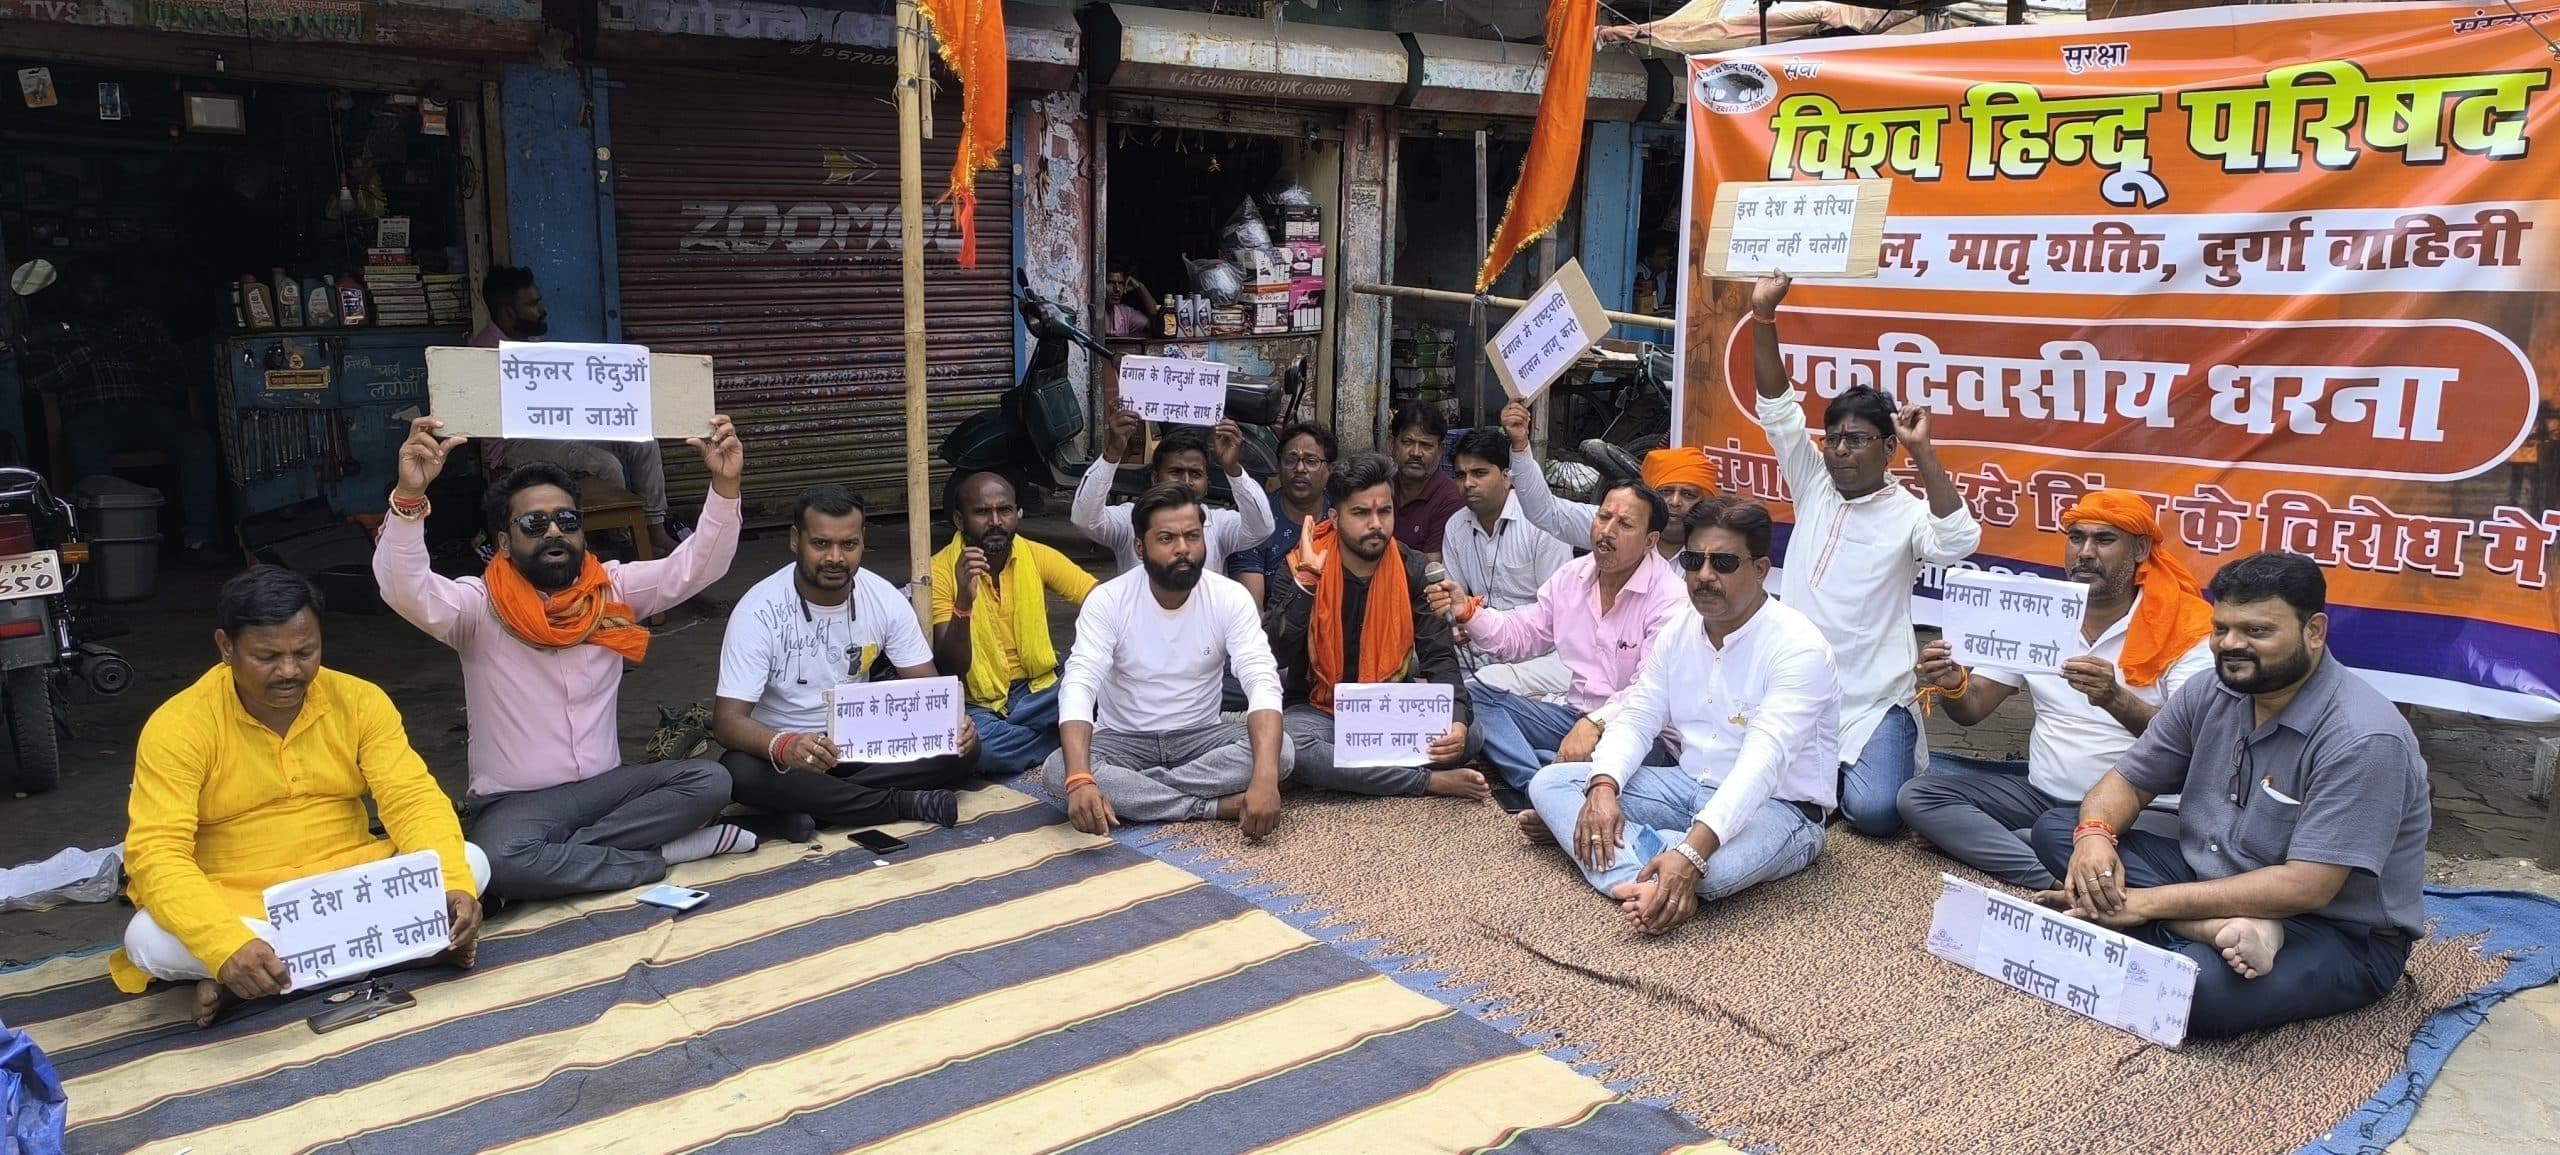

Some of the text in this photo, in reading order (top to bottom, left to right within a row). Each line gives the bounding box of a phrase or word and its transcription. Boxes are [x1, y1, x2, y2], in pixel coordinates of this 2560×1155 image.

[1783, 57, 1824, 81] सेवा
[2062, 43, 2129, 74] सुरक्षा
[1169, 71, 1249, 92] KATCHAHRI
[1768, 59, 2552, 206] विश्व हिन्दू परिषद
[1737, 194, 1855, 220] इस देश में सरिया
[1732, 232, 1849, 261] कानून नहीं चलेगी
[1879, 208, 2534, 288] ल, मातृ शक्ति, दुर्गा वाहिनी
[1501, 292, 1567, 360] बंगाल में राष्ट्रपति
[1517, 317, 1579, 380] शासन लागू करो
[502, 354, 648, 392] सेकुलर हिंदुओं
[1121, 361, 1221, 391] बंगाल के हिन्दुओं संघर्ष
[1778, 332, 2460, 443] एकदिवसीय धरना
[526, 402, 639, 427] जाग जाओ
[1145, 401, 1160, 417] हम
[1163, 401, 1190, 421] तुम्हारे
[1194, 405, 1212, 419] साथ
[1215, 402, 1223, 421] हैं
[1956, 463, 2021, 526] रहे
[2174, 483, 2250, 554] के
[2257, 489, 2474, 577] विरोध
[2479, 504, 2560, 588] में
[1945, 583, 2083, 620] ममता सरकार को
[1964, 630, 2060, 667] बर्खास्त करो
[837, 688, 949, 721] बंगाल के हिन्दुओं संघर्ष
[1336, 693, 1452, 718] बंगाल में राष्ट्रपति
[867, 740, 882, 758] हम
[888, 732, 918, 758] तुम्हारे
[922, 734, 943, 751] साथ
[1345, 732, 1384, 747] शासन
[1391, 732, 1421, 753] लागू
[268, 866, 440, 931] इस देश में सरिया
[279, 909, 448, 979] कानून नहीं चलेगी
[1987, 896, 2034, 933] ममता
[2041, 915, 2096, 957] सरकार
[2104, 937, 2128, 968] को
[2002, 958, 2099, 1016] बर्खास्त करो
